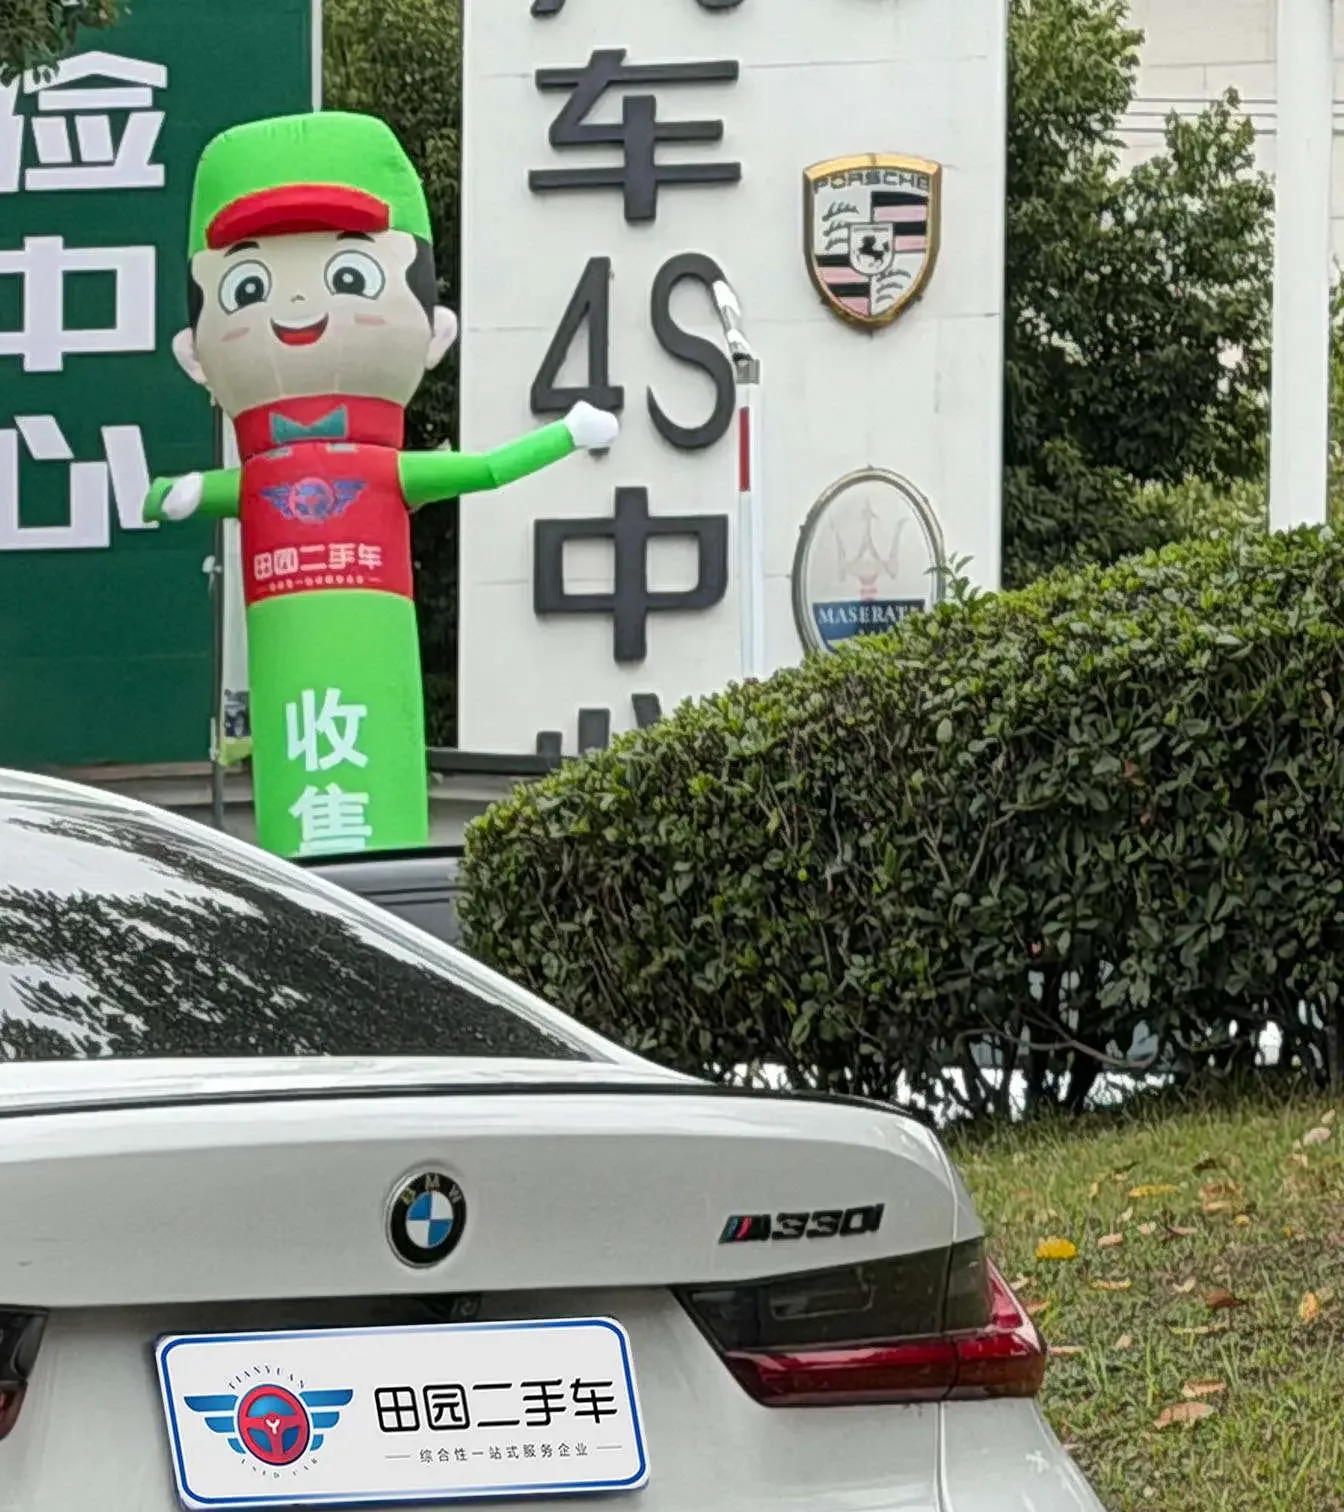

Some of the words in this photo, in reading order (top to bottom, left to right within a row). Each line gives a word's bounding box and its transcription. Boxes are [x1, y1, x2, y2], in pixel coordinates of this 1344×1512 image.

[813, 168, 930, 194] PORSCHE
[528, 0, 743, 762] 车4S中
[818, 604, 920, 624] MASERAT
[285, 687, 373, 856] 收售
[374, 1378, 618, 1433] 田园二手车
[419, 1442, 588, 1464] 综合性一站式服务企业
